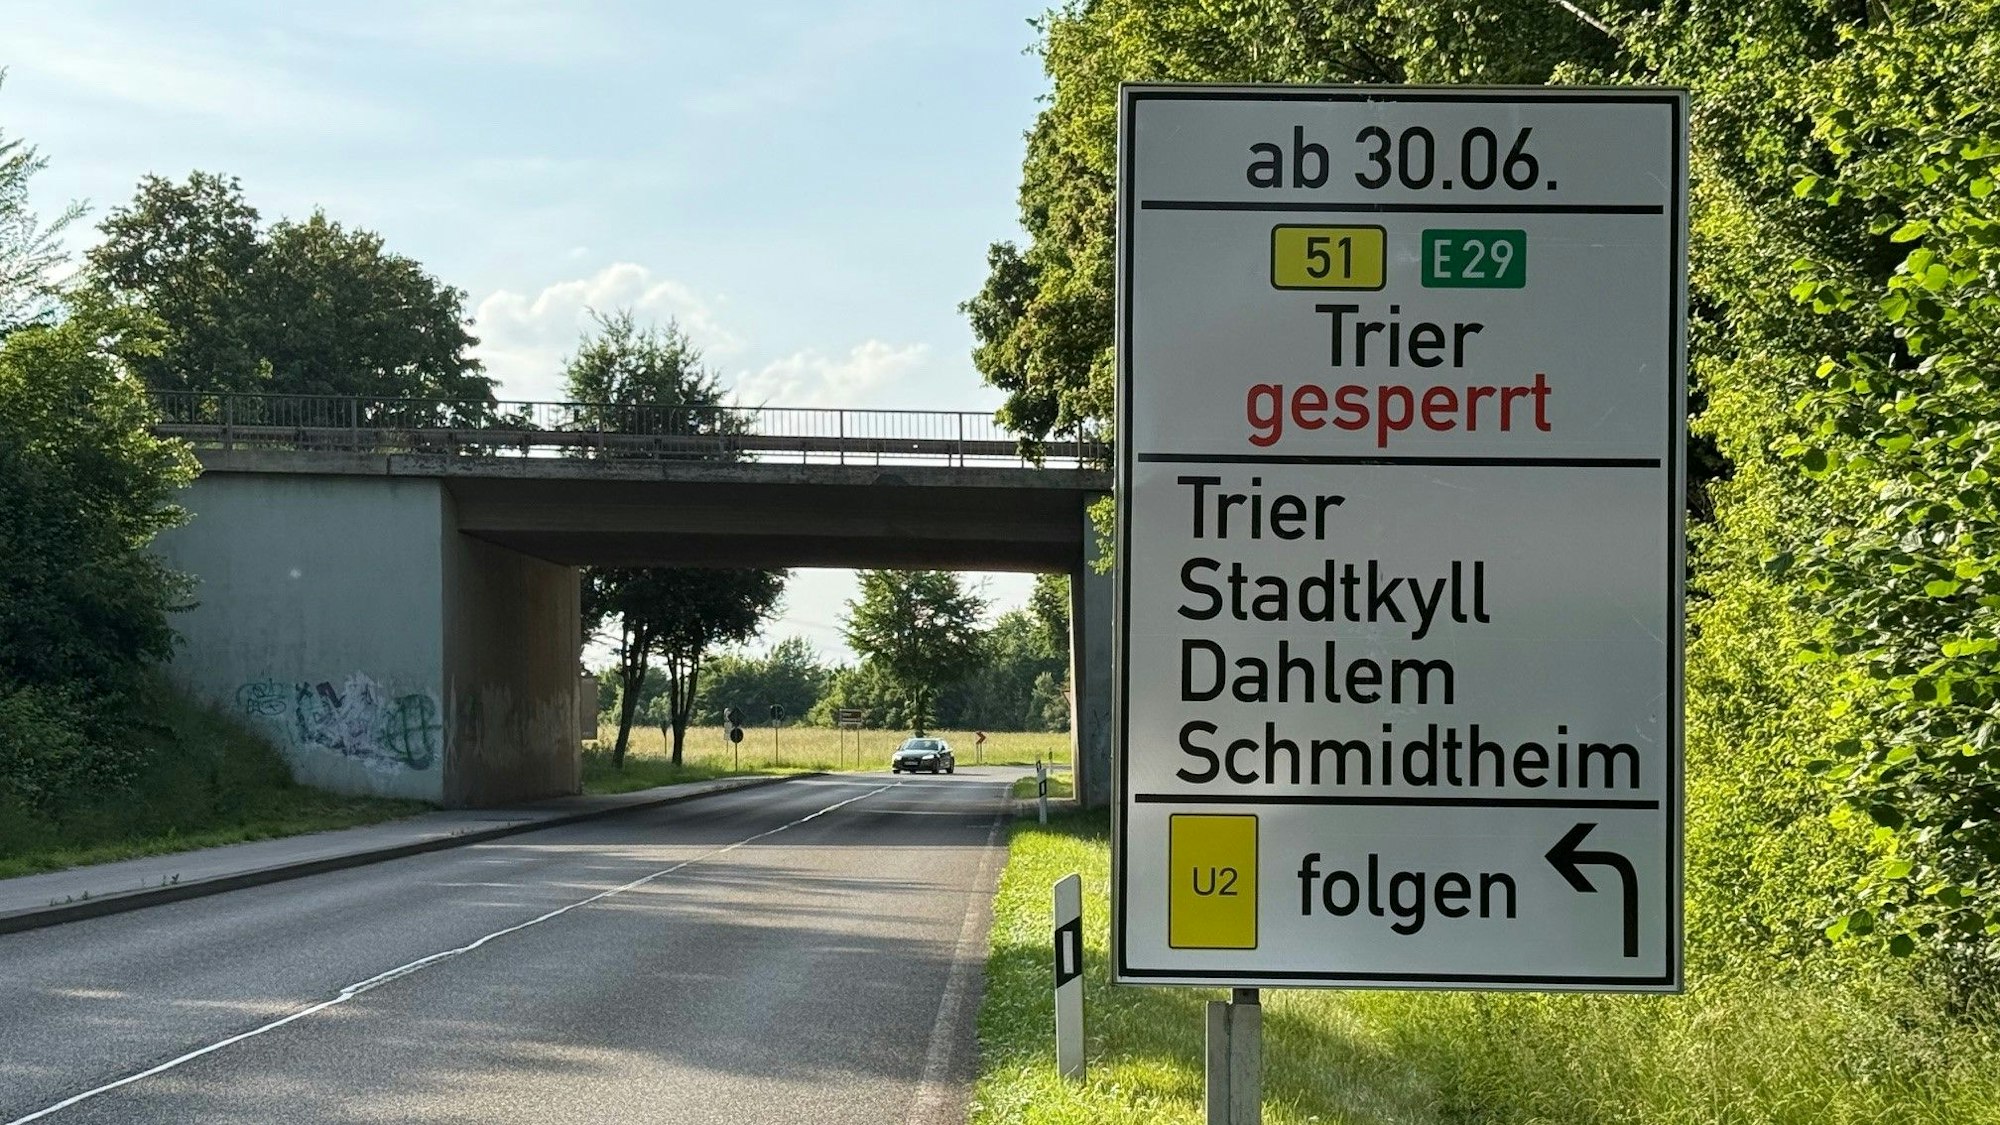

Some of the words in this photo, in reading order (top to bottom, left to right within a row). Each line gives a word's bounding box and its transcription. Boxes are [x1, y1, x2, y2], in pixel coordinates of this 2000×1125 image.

[1247, 126, 1329, 188] ab
[1355, 126, 1557, 190] 30.06.
[1306, 237, 1351, 279] 51
[1315, 304, 1484, 368] Trier
[1247, 374, 1551, 447] gesperrt
[1178, 476, 1346, 540] Trier
[1178, 558, 1490, 640] Stadtkyll
[1182, 639, 1454, 704] Dahlem
[1176, 721, 1641, 789] Schmidtheim
[1192, 867, 1239, 897] U2
[1297, 853, 1517, 935] folgen
